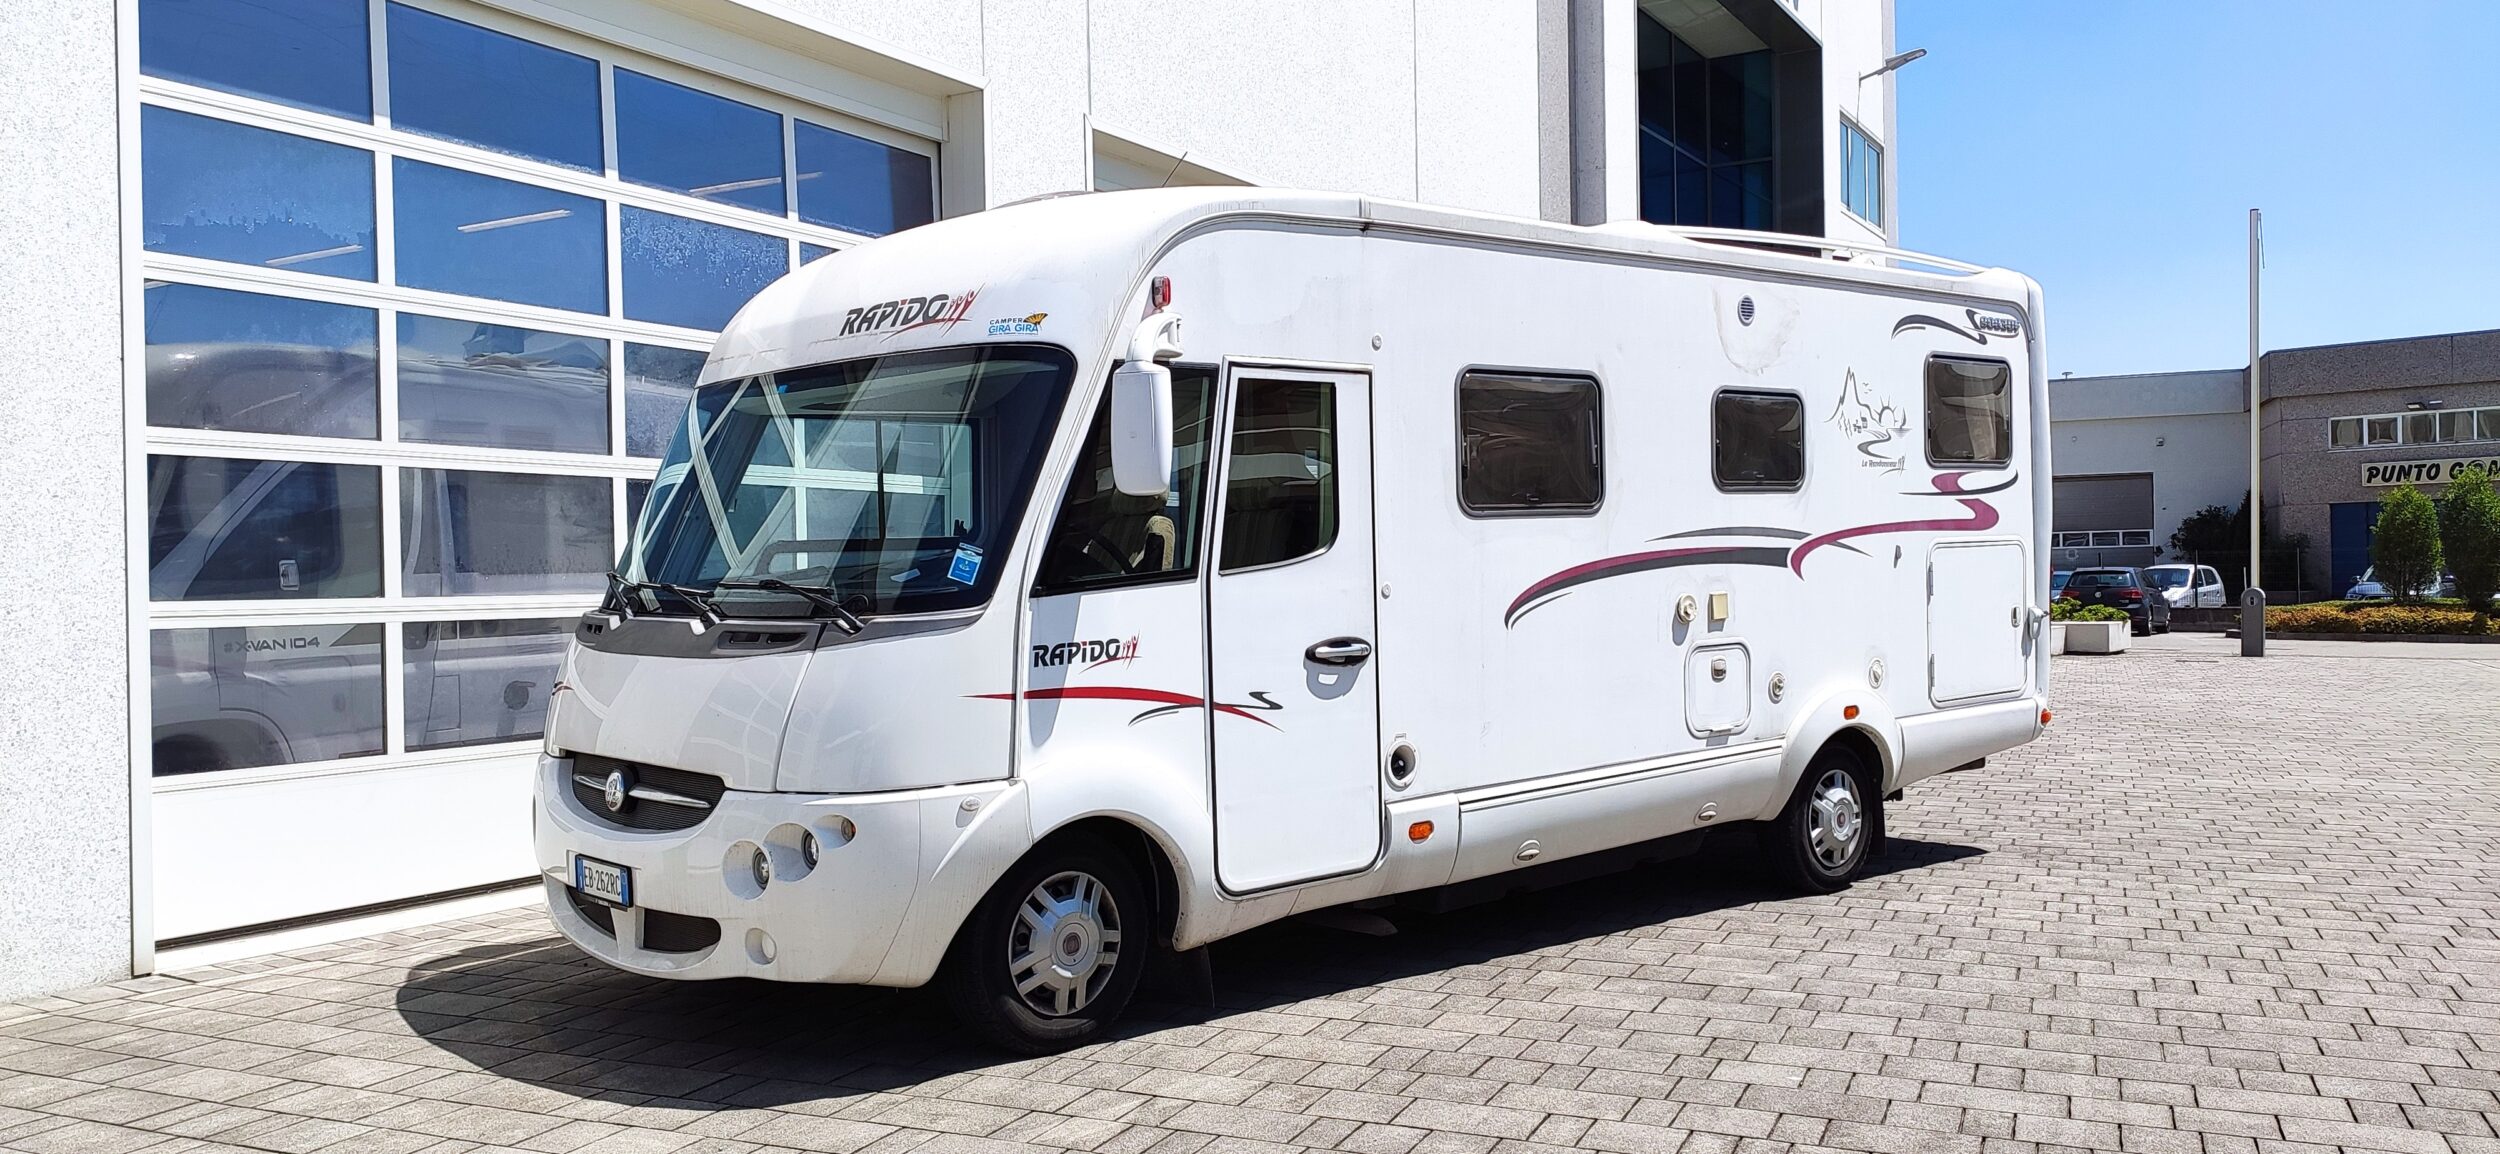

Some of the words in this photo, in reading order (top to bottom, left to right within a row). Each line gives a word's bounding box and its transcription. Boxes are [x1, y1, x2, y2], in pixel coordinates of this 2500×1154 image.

[839, 294, 950, 336] RAPIDO
[989, 317, 1023, 325] CAMPER
[988, 324, 1011, 333] GIRA
[1014, 323, 1038, 332] GIRA
[2366, 463, 2441, 484] PUNTO
[1032, 638, 1121, 667] RAPIDO
